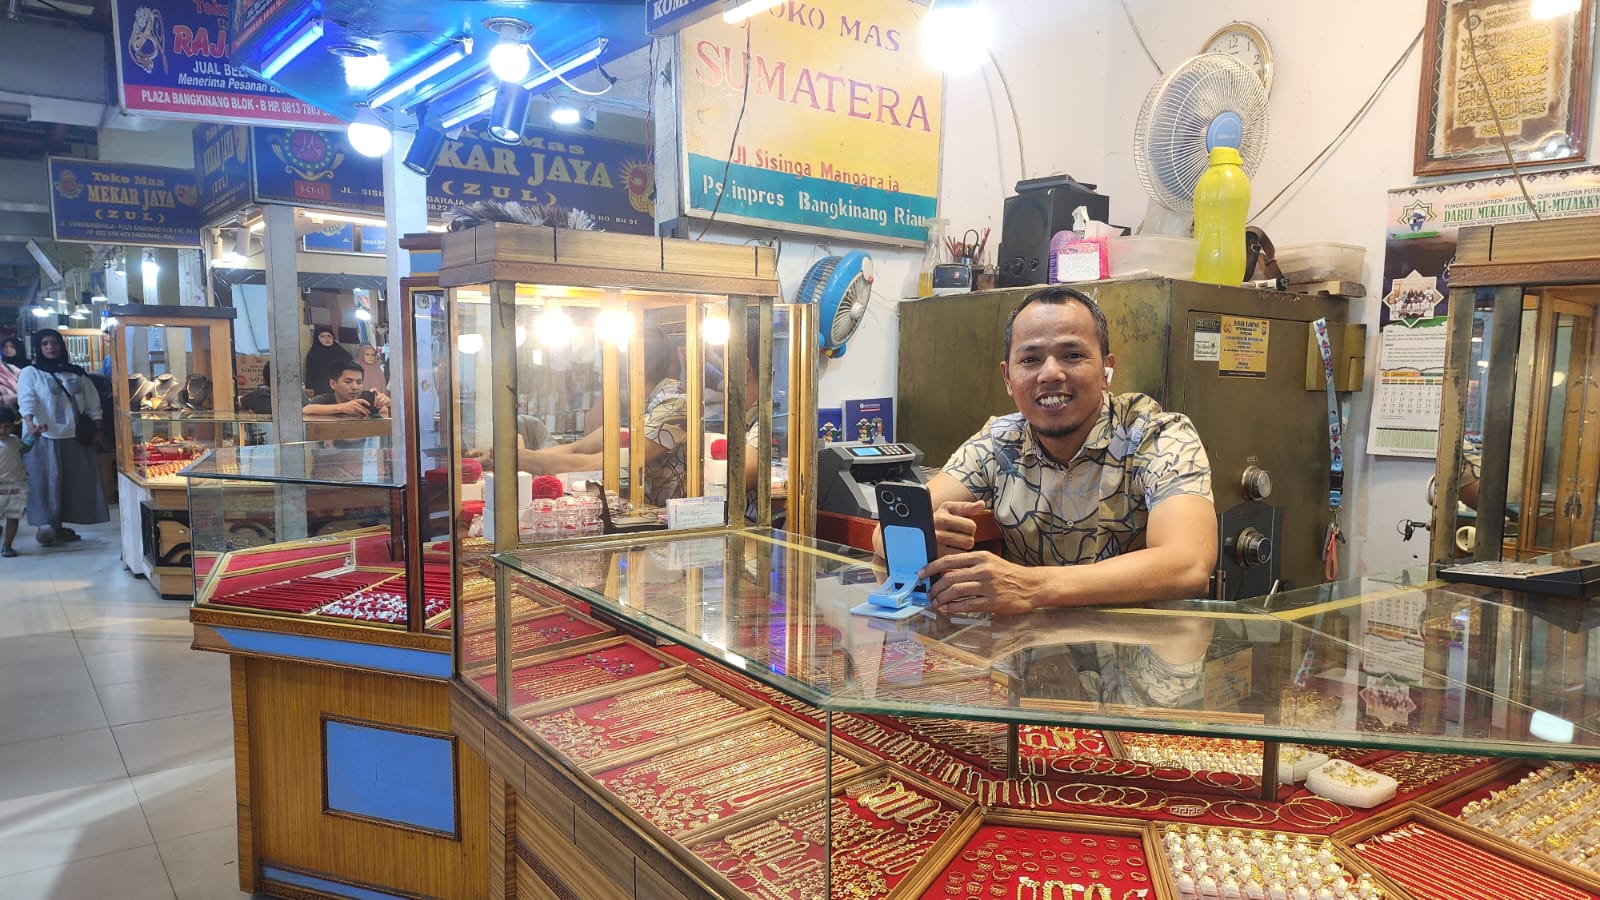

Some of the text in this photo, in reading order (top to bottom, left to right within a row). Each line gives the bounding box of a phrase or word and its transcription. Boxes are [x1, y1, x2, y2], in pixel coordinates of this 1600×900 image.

[173, 25, 230, 58] RAJ
[839, 15, 901, 52] MAS
[193, 60, 222, 77] JUAL
[178, 73, 226, 89] Menerima
[228, 78, 268, 93] Pesanan
[695, 40, 932, 132] SUMATERA
[141, 90, 171, 104] PLAZA
[172, 93, 230, 109] BANGKINANG
[231, 97, 255, 110] BLOK
[260, 99, 266, 111] B
[268, 101, 281, 113] HP.
[282, 101, 301, 114] 0813
[522, 136, 585, 155] Mas
[527, 153, 614, 189] JAYA
[756, 148, 812, 179] Sisinga
[91, 171, 165, 187] Toko Mas
[87, 184, 141, 206] MEKAR
[142, 188, 176, 210] JAYA
[798, 190, 888, 227] Bangkinang
[893, 206, 926, 229] Riau
[1443, 206, 1475, 223] DARUL
